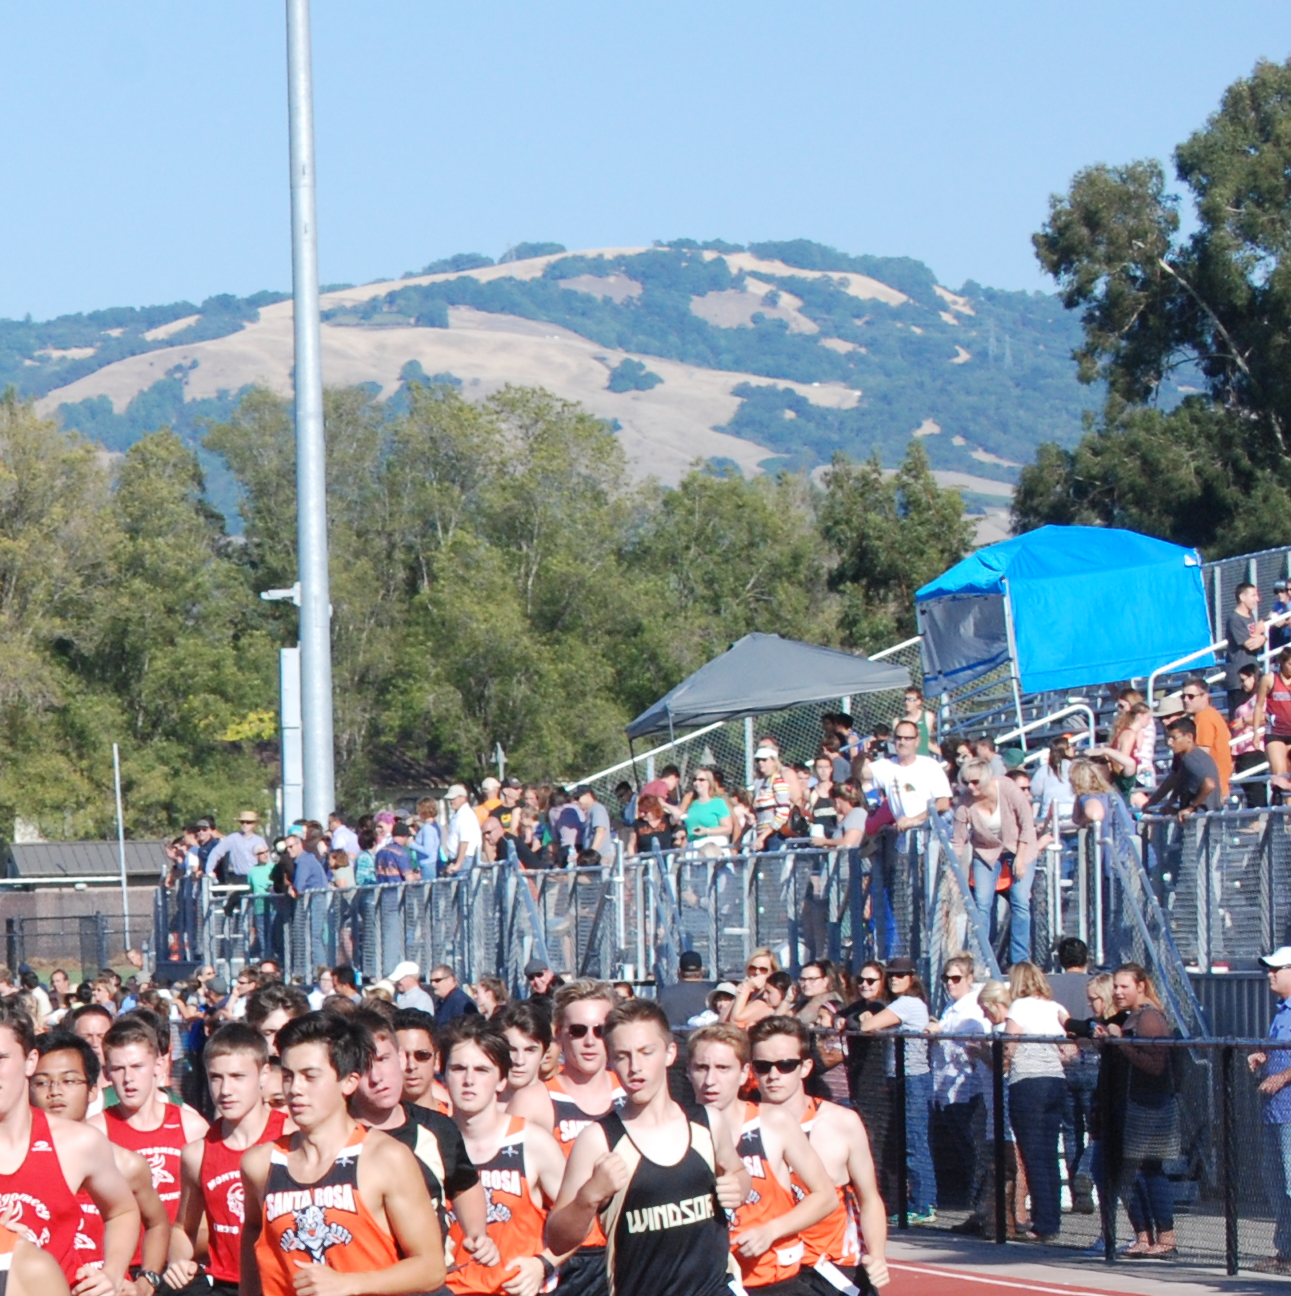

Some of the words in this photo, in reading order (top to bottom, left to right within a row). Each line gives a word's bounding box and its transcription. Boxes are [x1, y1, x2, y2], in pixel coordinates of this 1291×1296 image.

[743, 1154, 765, 1178] SA
[480, 1169, 522, 1197] ROSA
[265, 1190, 312, 1222] SANTA
[314, 1183, 357, 1213] ROSA
